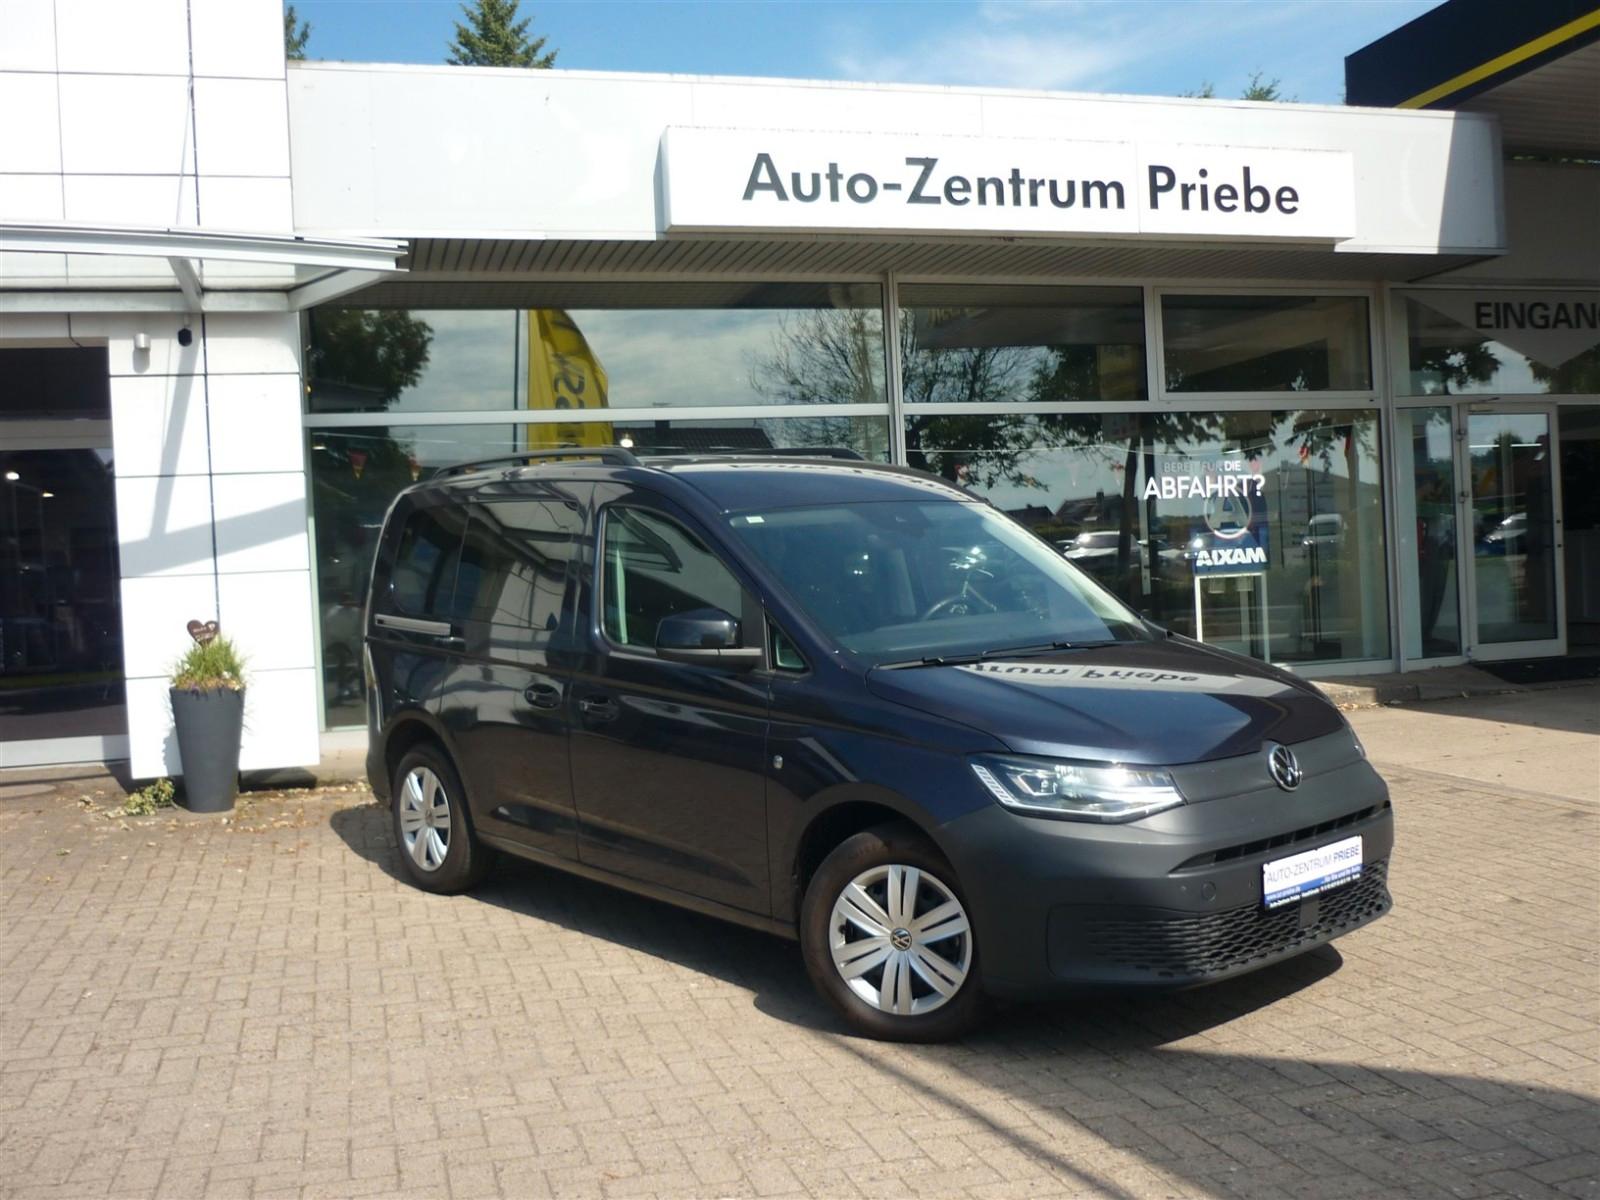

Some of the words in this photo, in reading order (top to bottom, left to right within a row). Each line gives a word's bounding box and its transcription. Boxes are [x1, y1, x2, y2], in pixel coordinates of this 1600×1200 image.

[742, 152, 1125, 210] Auto-Zentrum
[1148, 164, 1299, 214] Priebe
[1475, 302, 1600, 329] EINGAN
[1224, 460, 1242, 472] DIE
[1144, 475, 1265, 500] ABFAHRT?
[1196, 547, 1267, 567] AIXAM
[1266, 855, 1332, 883] AUTO-ZENTRUM
[1333, 845, 1360, 864] PRIEBE
